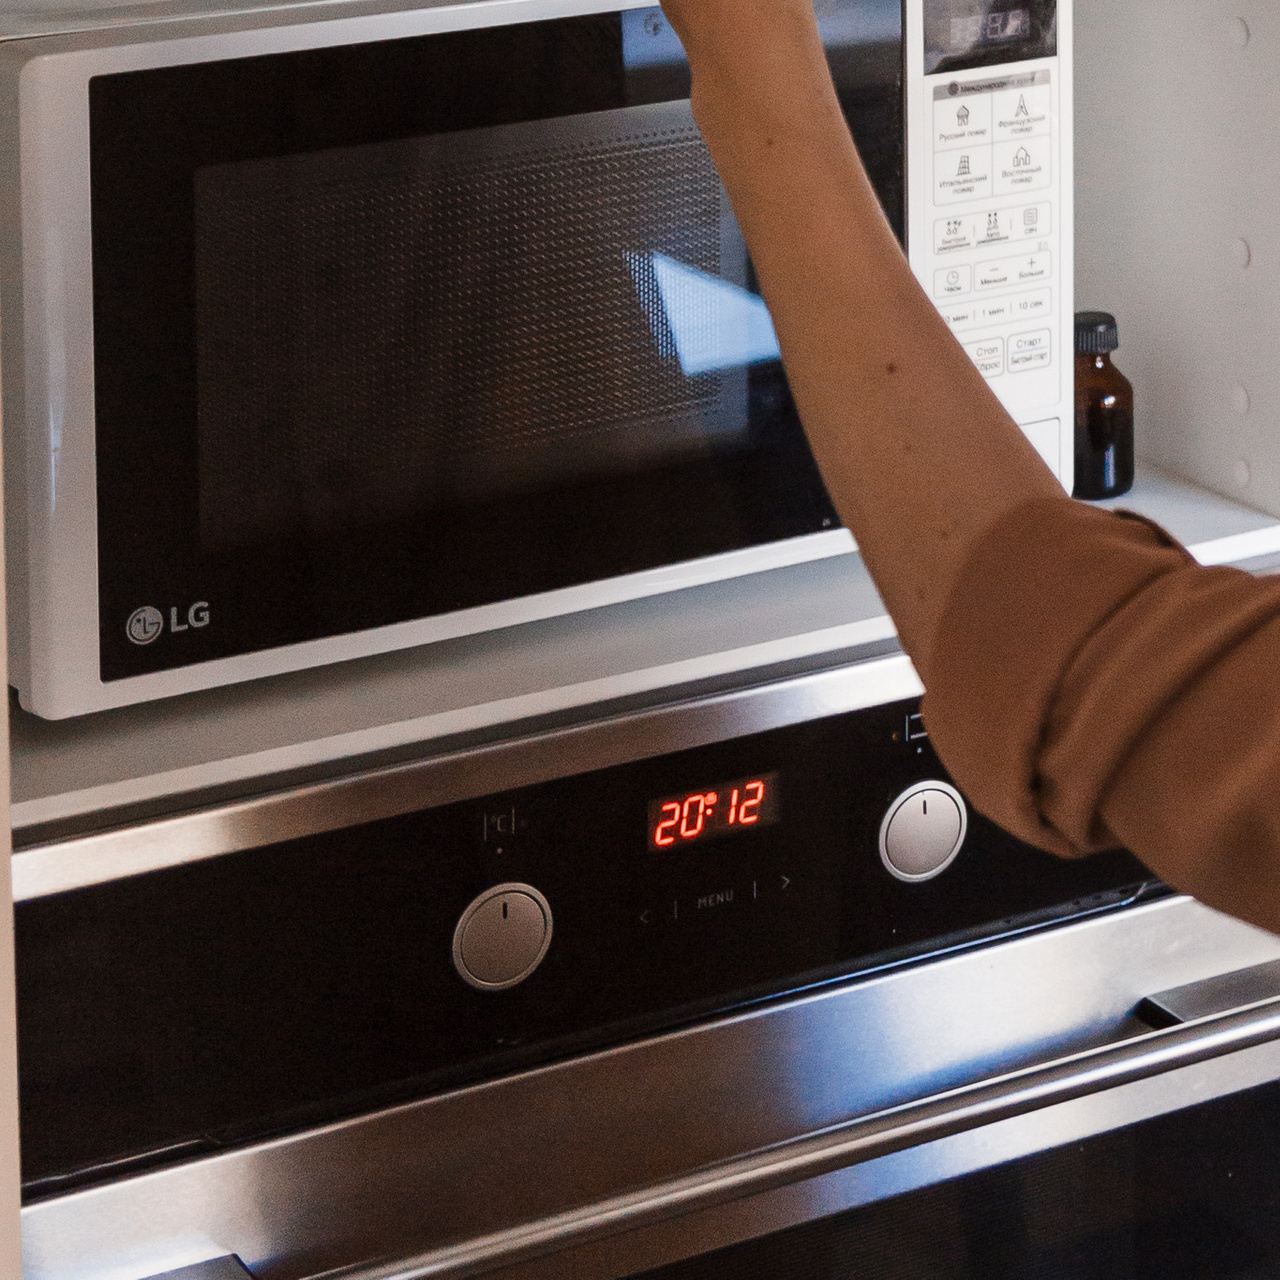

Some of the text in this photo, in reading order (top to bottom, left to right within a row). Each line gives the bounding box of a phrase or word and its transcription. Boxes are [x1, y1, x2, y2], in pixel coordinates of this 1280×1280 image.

[976, 347, 999, 357] Стоп
[170, 601, 210, 633] LG
[655, 780, 764, 846] 20:12
[697, 890, 734, 908] MENU
